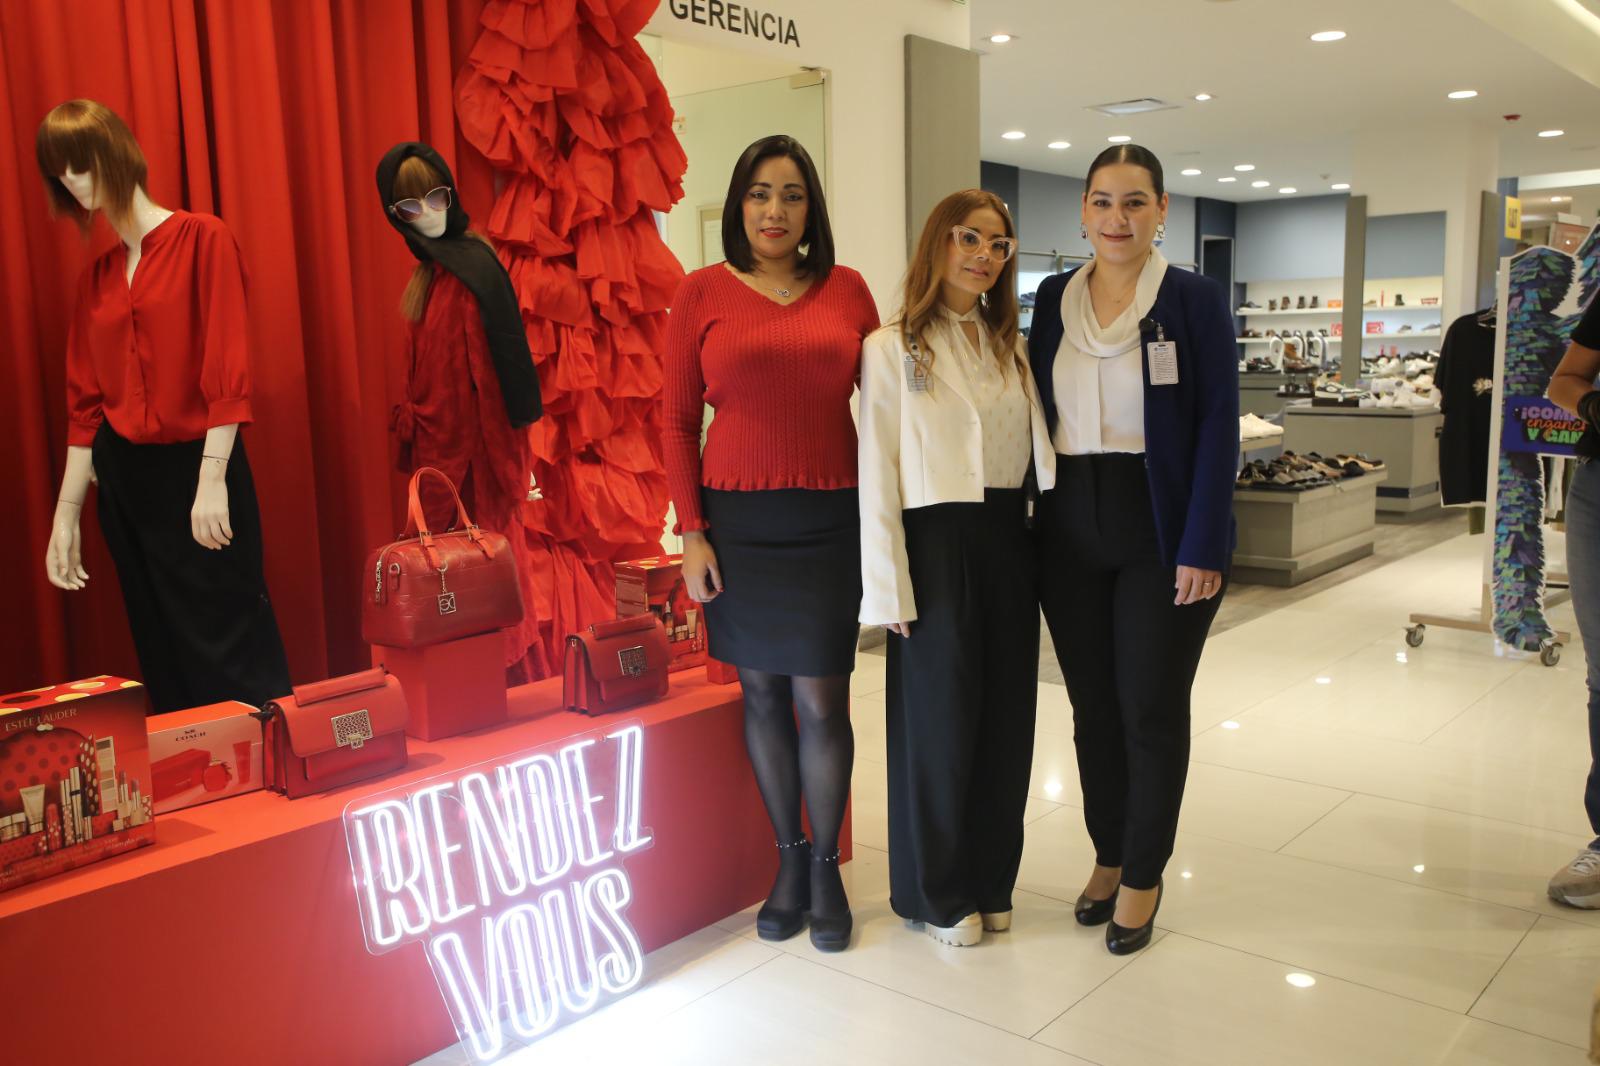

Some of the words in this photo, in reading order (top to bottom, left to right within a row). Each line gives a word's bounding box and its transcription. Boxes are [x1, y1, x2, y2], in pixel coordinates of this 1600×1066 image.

[669, 0, 801, 48] GERENCIA
[1543, 428, 1584, 444] GAN
[37, 708, 78, 723] LAUDER
[351, 725, 653, 946] RENDEZ
[432, 867, 644, 1061] VOUS
